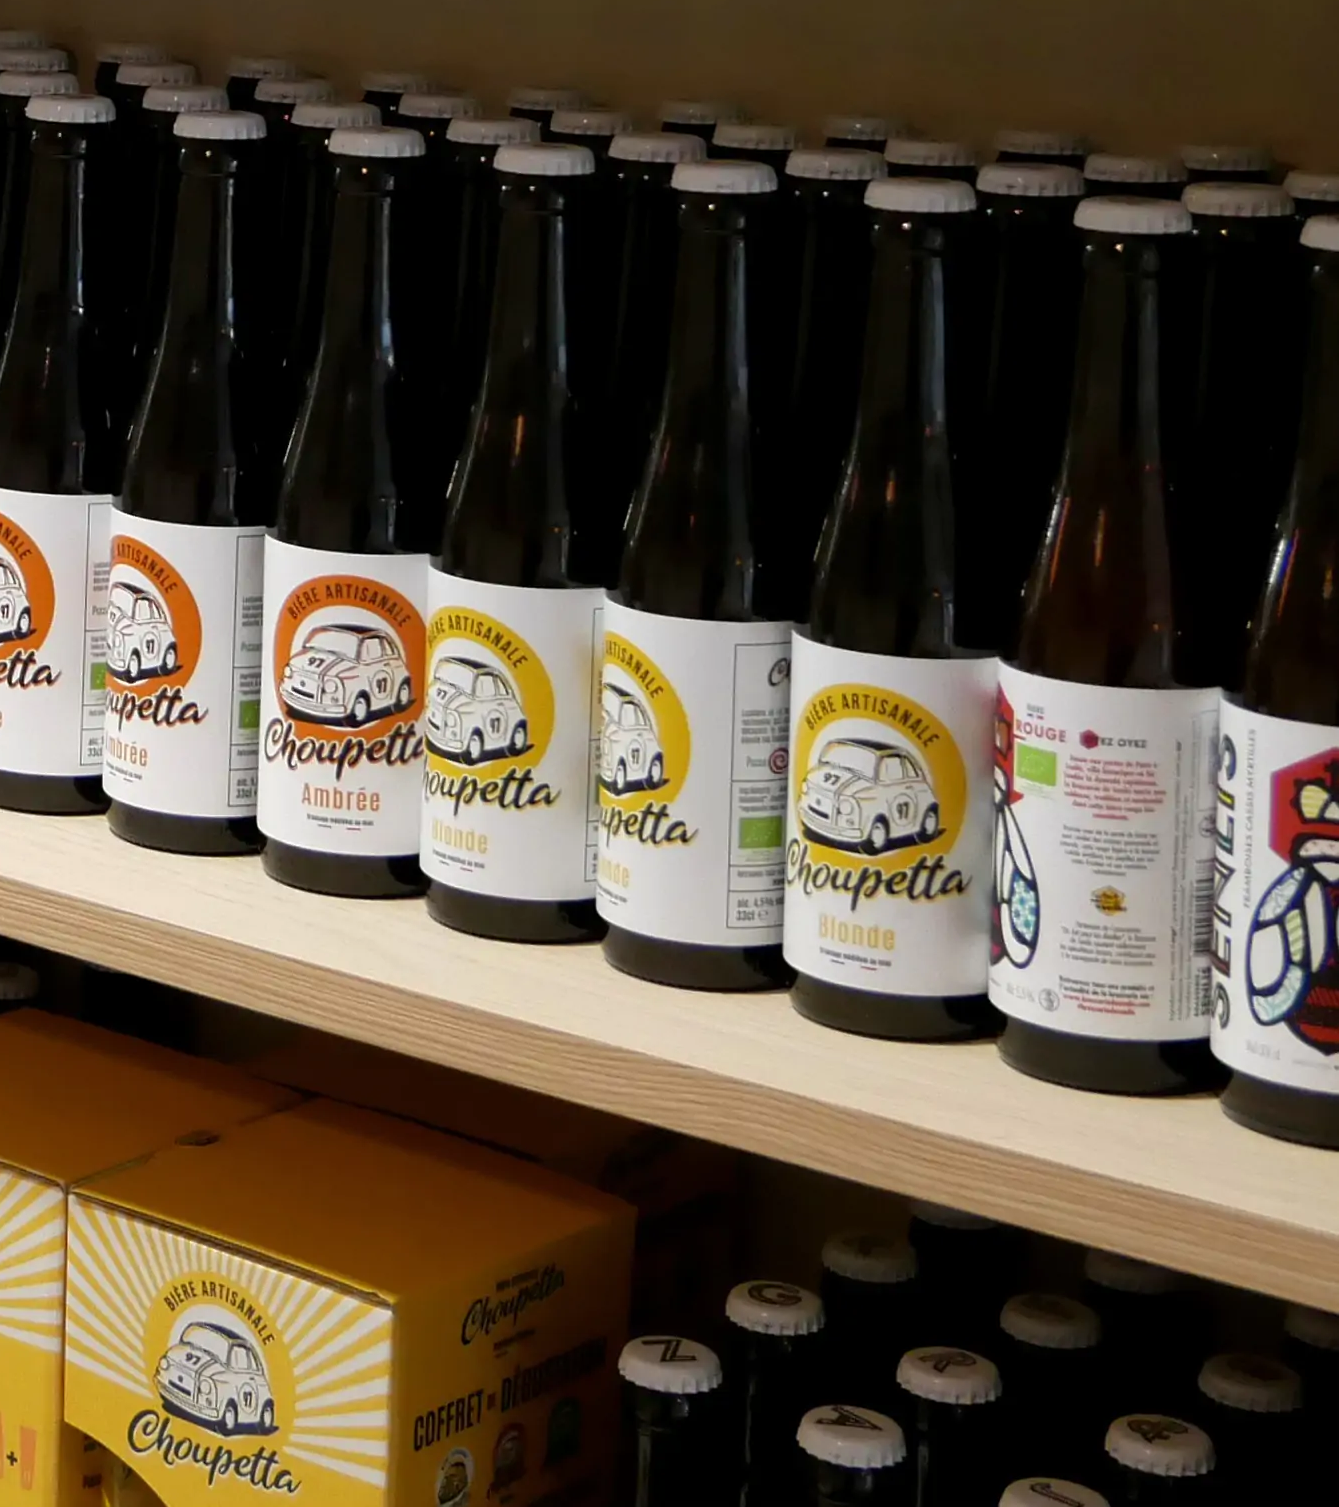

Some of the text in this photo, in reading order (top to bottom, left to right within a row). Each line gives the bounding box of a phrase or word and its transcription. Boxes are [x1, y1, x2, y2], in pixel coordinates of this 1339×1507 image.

[0, 605, 10, 619] 97
[287, 582, 412, 628] BIÈRE ARTISANALE
[145, 638, 155, 654] 97
[448, 614, 529, 670] ARTISANALE
[307, 656, 324, 669] 97
[376, 677, 389, 693] 97
[489, 716, 502, 734] 97
[805, 696, 837, 731] BIÈRE
[841, 692, 939, 749] ARTISANALE
[1014, 718, 1067, 743] ROUGE
[422, 755, 561, 817] houpetta
[822, 772, 841, 786] 97
[301, 783, 381, 812] Ambrée
[896, 802, 909, 819] 97
[786, 838, 972, 912] Choupetta
[819, 913, 896, 952] Blonde
[164, 1279, 275, 1346] BIÈRE ARTISANALE
[461, 1261, 565, 1345] Choupetta
[185, 1351, 201, 1366] 97
[243, 1391, 252, 1408] 97
[414, 1389, 484, 1451] COFFRET
[127, 1409, 301, 1494] Choupetta
